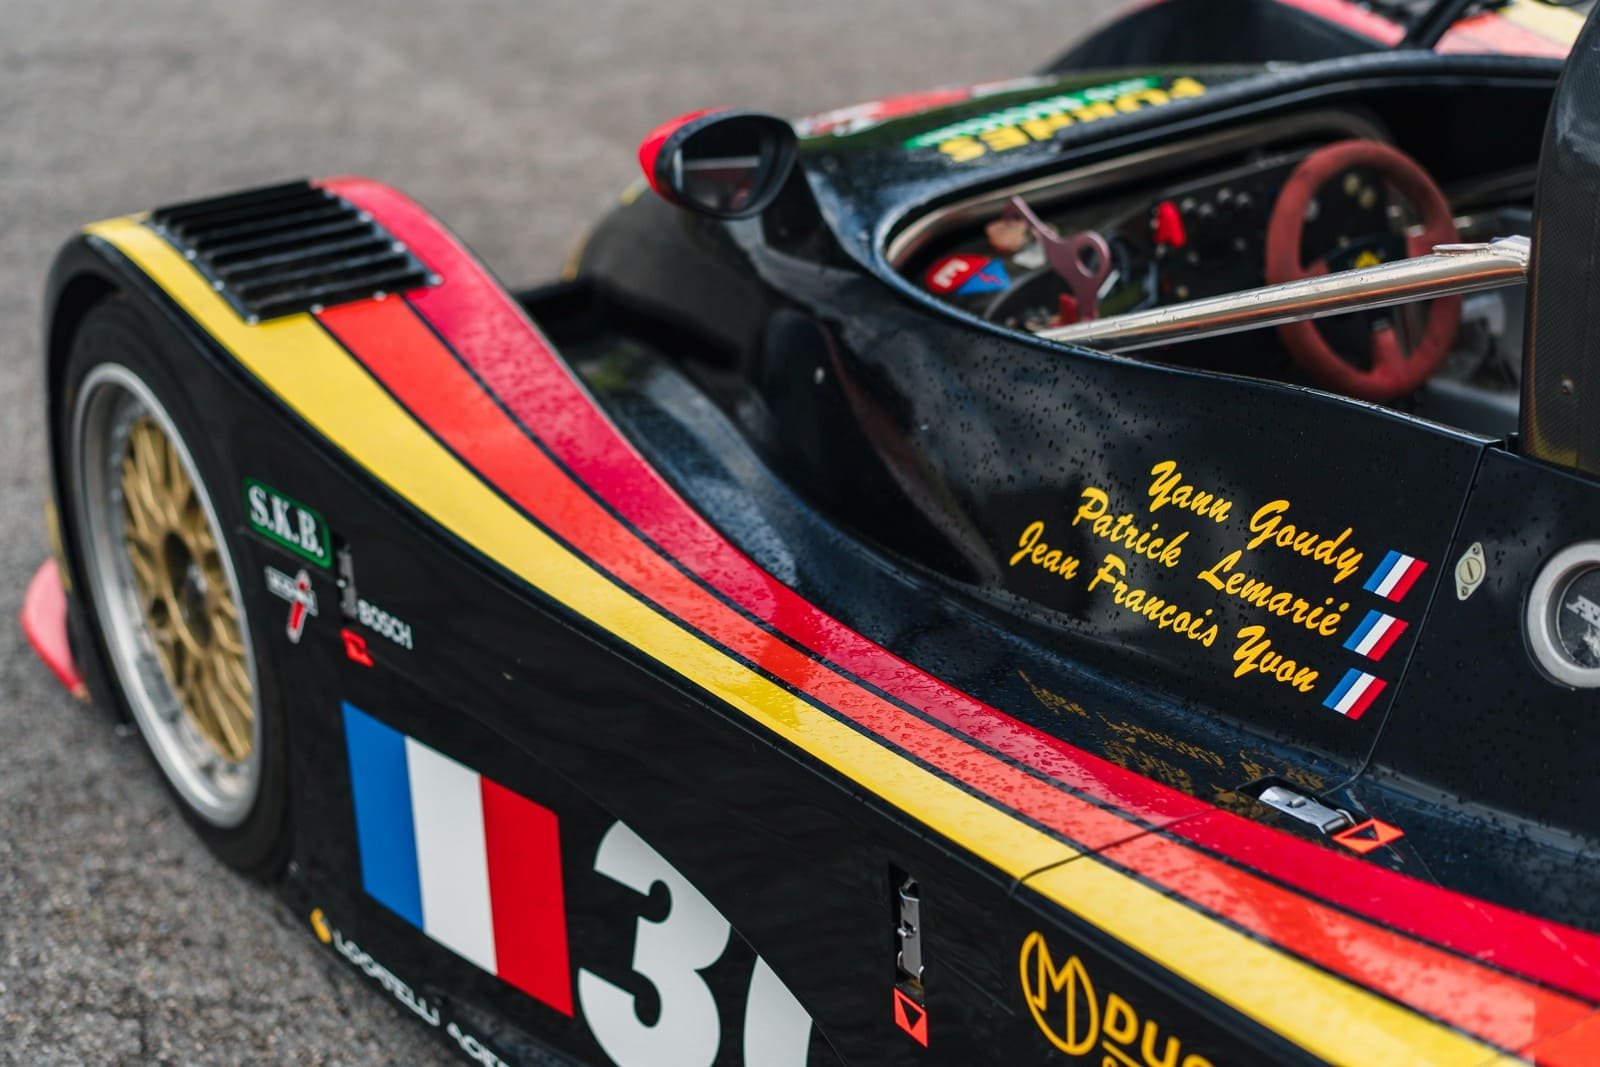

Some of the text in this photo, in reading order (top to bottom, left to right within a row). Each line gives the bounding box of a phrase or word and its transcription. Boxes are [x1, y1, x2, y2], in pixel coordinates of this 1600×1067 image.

[249, 485, 325, 558] S.K.B.
[1072, 486, 1350, 636] Patrick Lemarié
[1148, 460, 1364, 584] Yann Goudy
[357, 599, 413, 649] BOSCH
[1009, 521, 1319, 693] Jean François Yvon
[1102, 993, 1214, 1067] DU
